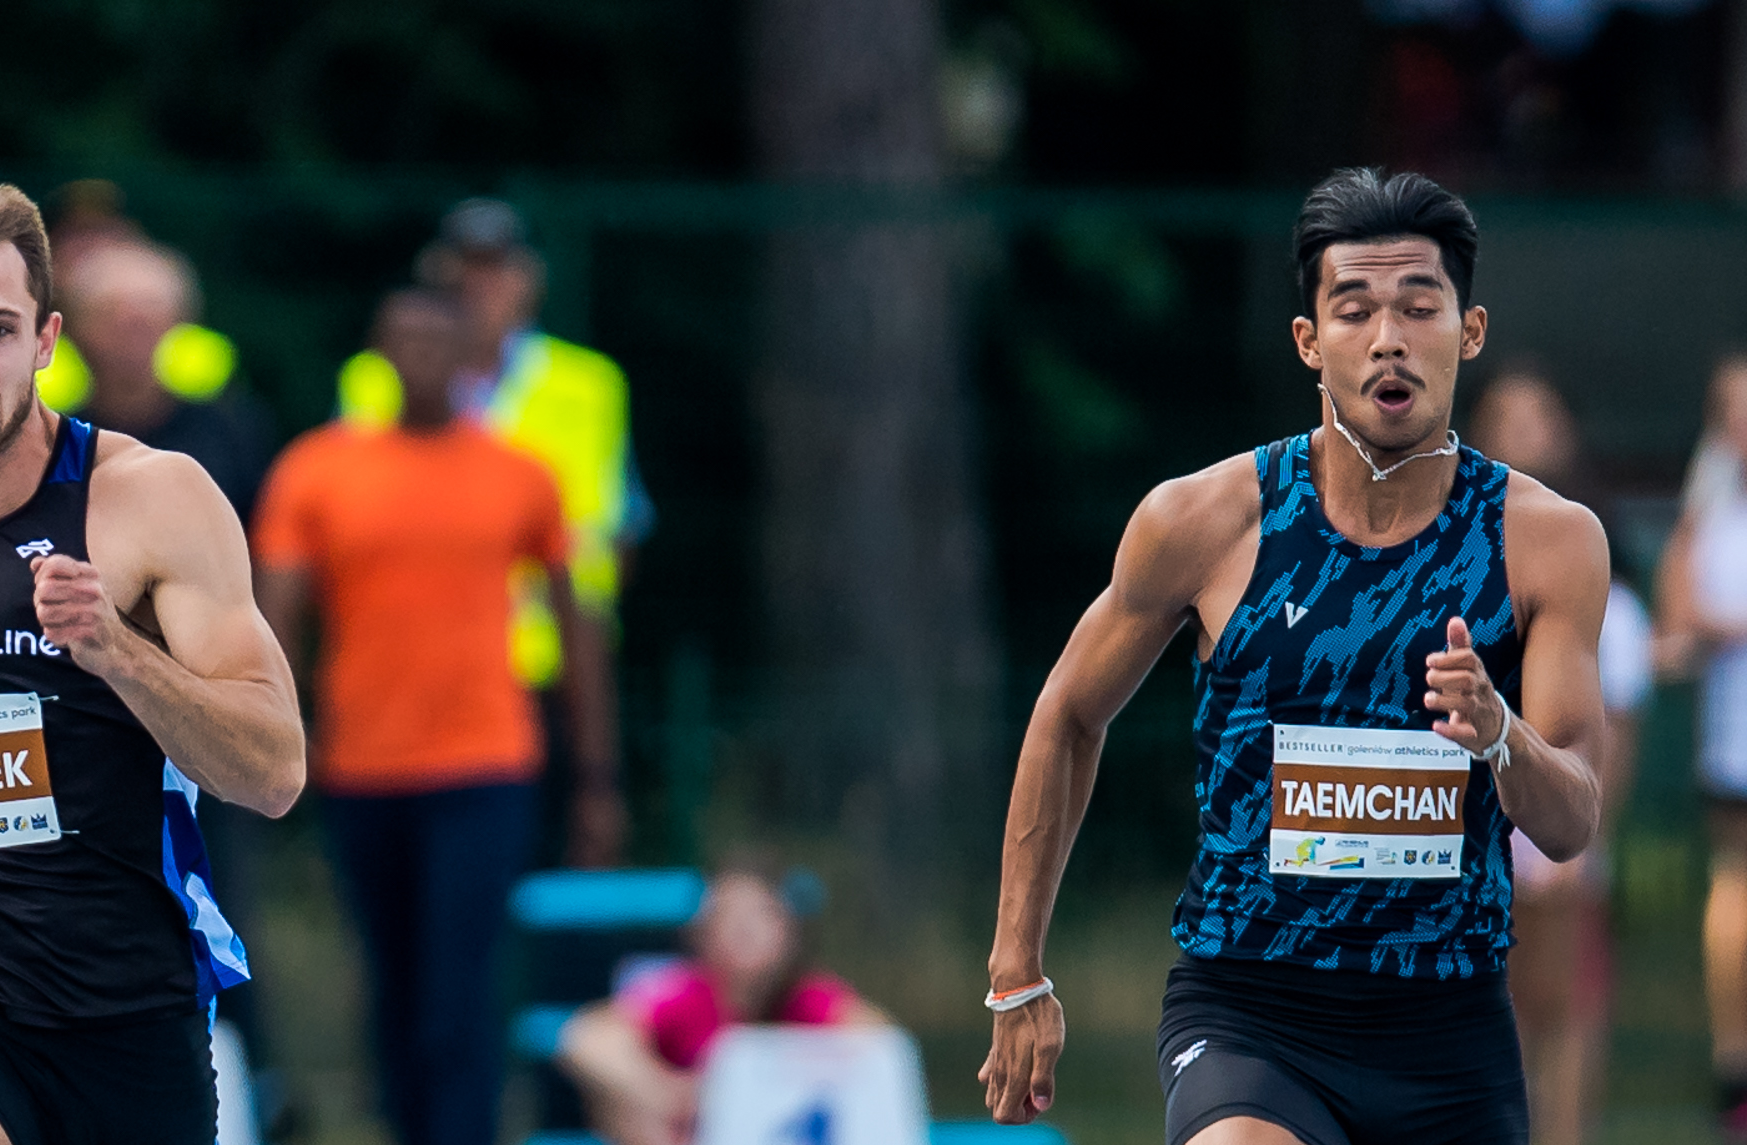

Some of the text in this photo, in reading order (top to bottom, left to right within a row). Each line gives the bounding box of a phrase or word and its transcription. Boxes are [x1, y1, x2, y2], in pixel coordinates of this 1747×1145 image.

[11, 705, 37, 719] park
[1279, 741, 1344, 753] BESTSELLER
[1394, 744, 1440, 756] athletics
[1442, 748, 1466, 759] park
[1281, 780, 1459, 821] TAEMCHAN
